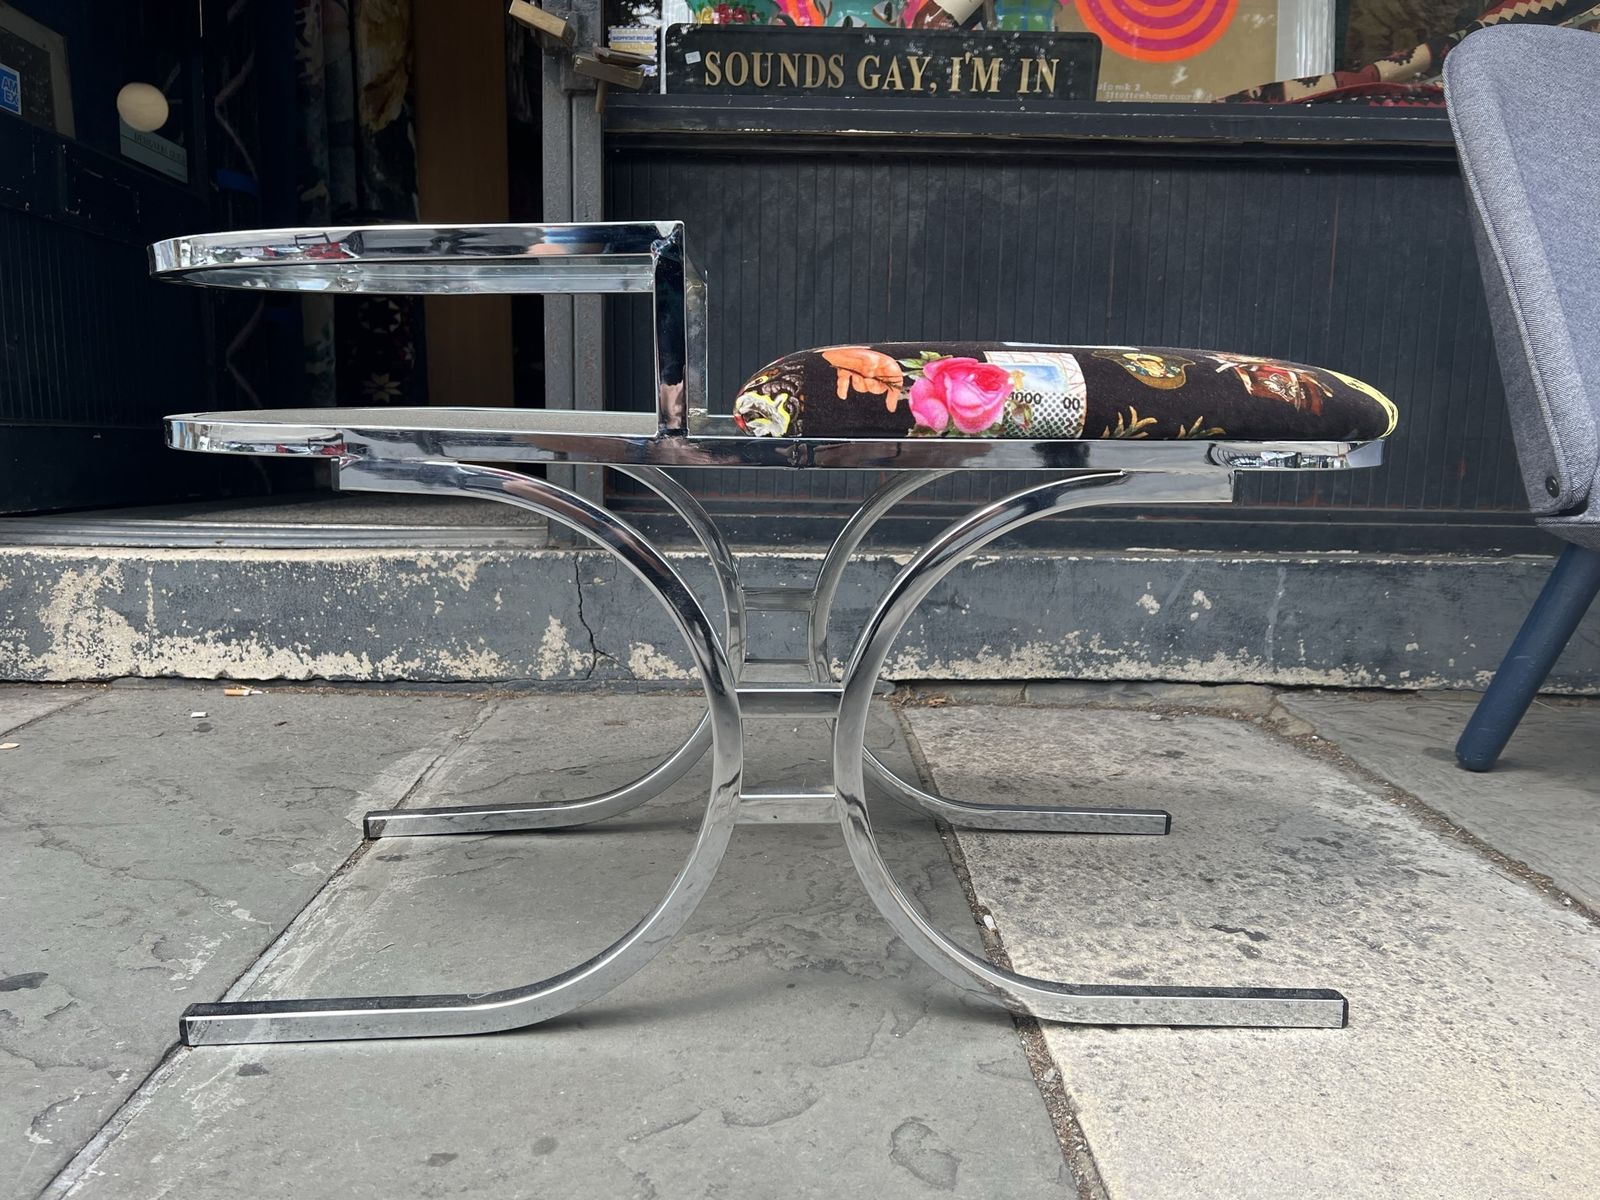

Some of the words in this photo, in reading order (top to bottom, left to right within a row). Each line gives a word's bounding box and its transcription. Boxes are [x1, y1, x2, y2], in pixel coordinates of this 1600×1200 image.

[704, 50, 845, 89] SOUNDS
[857, 54, 938, 94] GAY,
[949, 51, 1004, 92] I'M
[1016, 57, 1060, 93] IN
